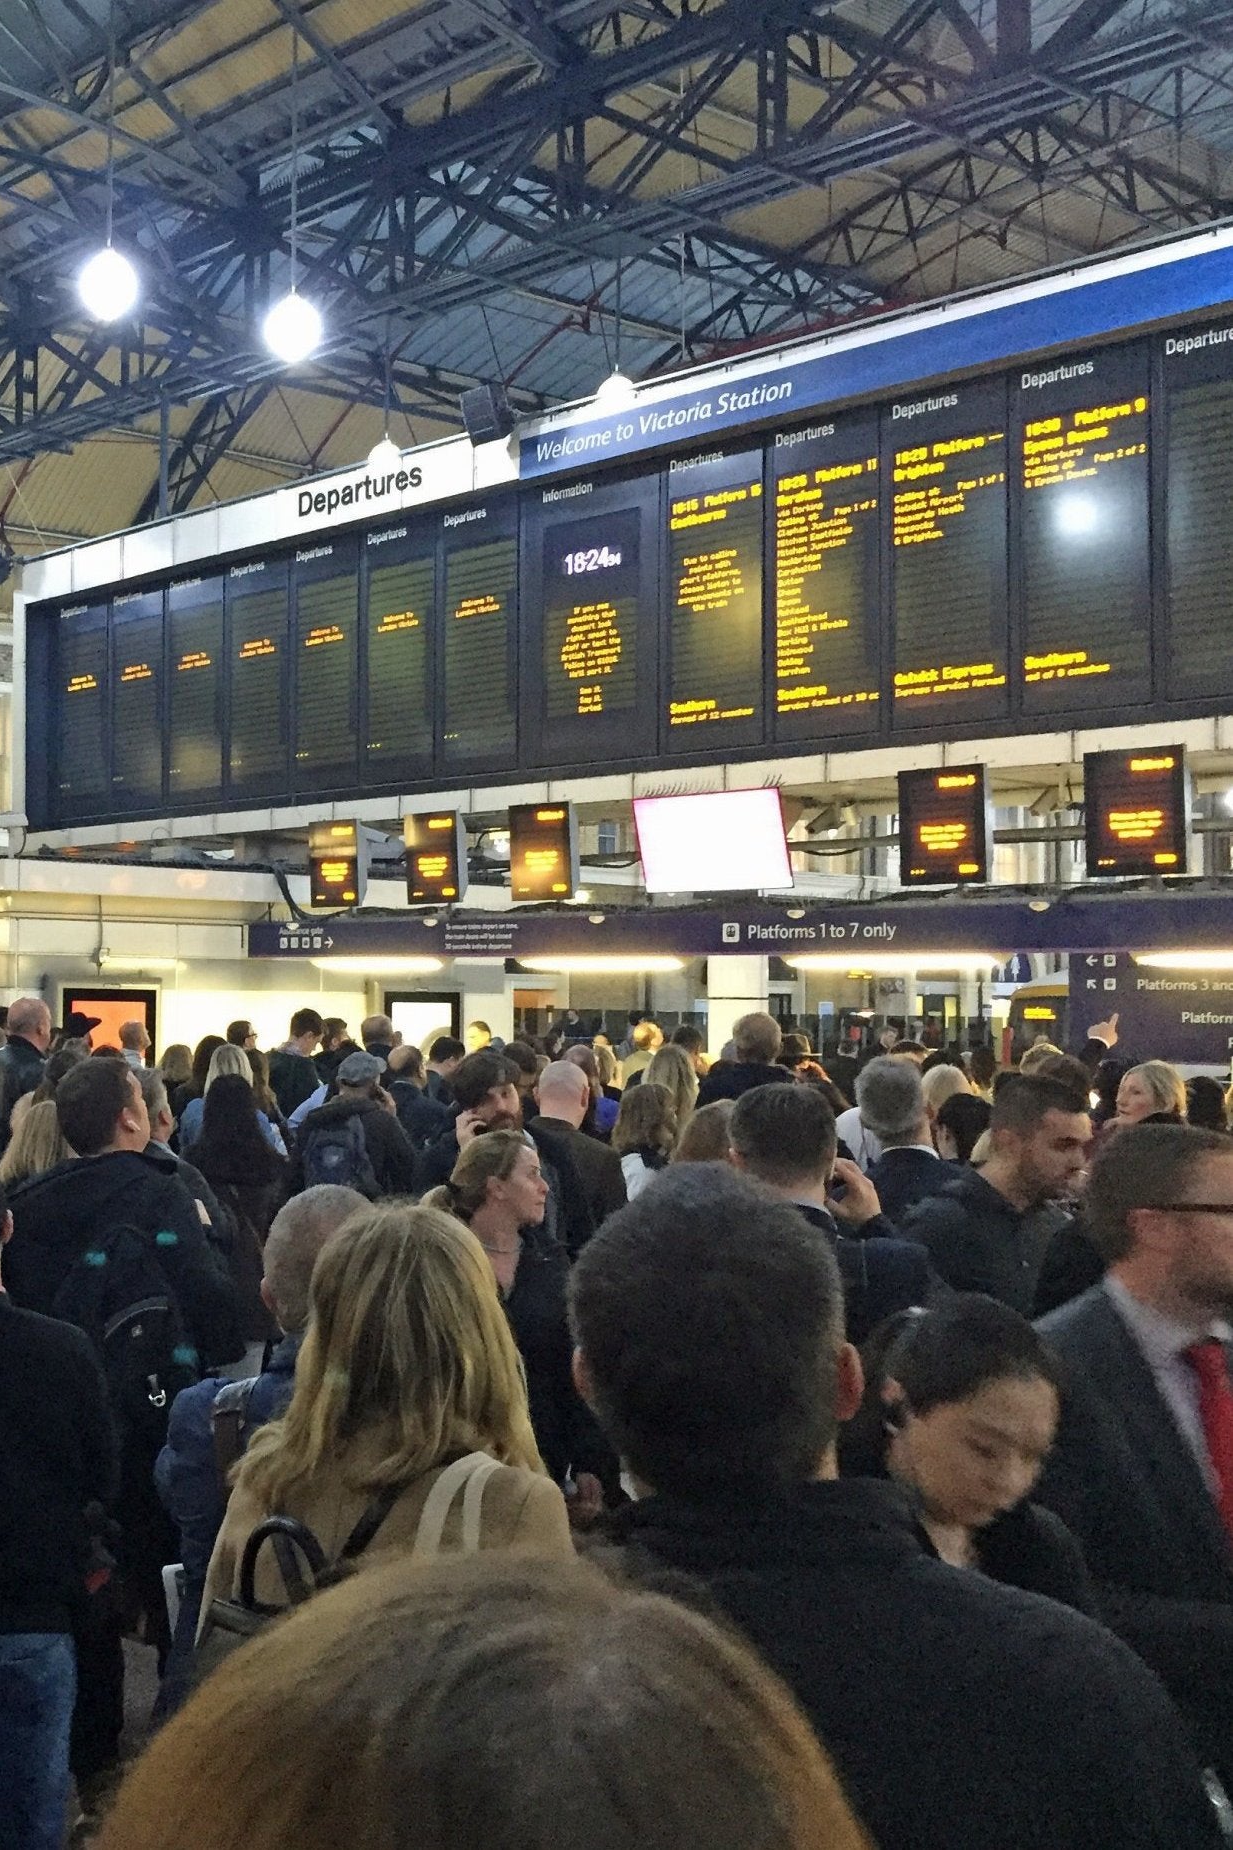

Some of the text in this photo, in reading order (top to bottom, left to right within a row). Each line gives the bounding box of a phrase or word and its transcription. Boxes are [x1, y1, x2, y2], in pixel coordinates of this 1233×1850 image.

[1166, 327, 1233, 356] Departure
[1021, 361, 1094, 389] Departures
[892, 393, 958, 420] Departures
[1074, 404, 1131, 427] Platform
[536, 380, 792, 464] Welcome to Victoria Station
[775, 423, 835, 448] Departures
[933, 436, 985, 458] Platform
[1116, 448, 1124, 457] 2
[1125, 445, 1137, 455] of
[1138, 443, 1146, 453] 2
[669, 451, 724, 473] Departures
[893, 461, 945, 482] Brighton
[815, 463, 863, 484] Platform
[298, 463, 422, 517] Departures
[542, 481, 593, 503] Information
[704, 488, 747, 508] Platform
[776, 488, 822, 507] Horsham
[871, 499, 877, 508] 2
[444, 508, 487, 528] Departures
[670, 508, 727, 530] Eastbourne
[811, 517, 848, 531] Junction
[367, 527, 407, 545] Departures
[811, 538, 846, 551] Junction
[295, 545, 333, 563] Departures
[230, 562, 265, 578] Departures
[1024, 651, 1087, 670] Southern
[894, 663, 994, 686] Gatwick Express
[777, 685, 828, 701] Southern
[670, 699, 716, 715] Southern
[747, 921, 897, 941] Platforms 1 to 7 only
[1137, 978, 1209, 991] Platforms 3
